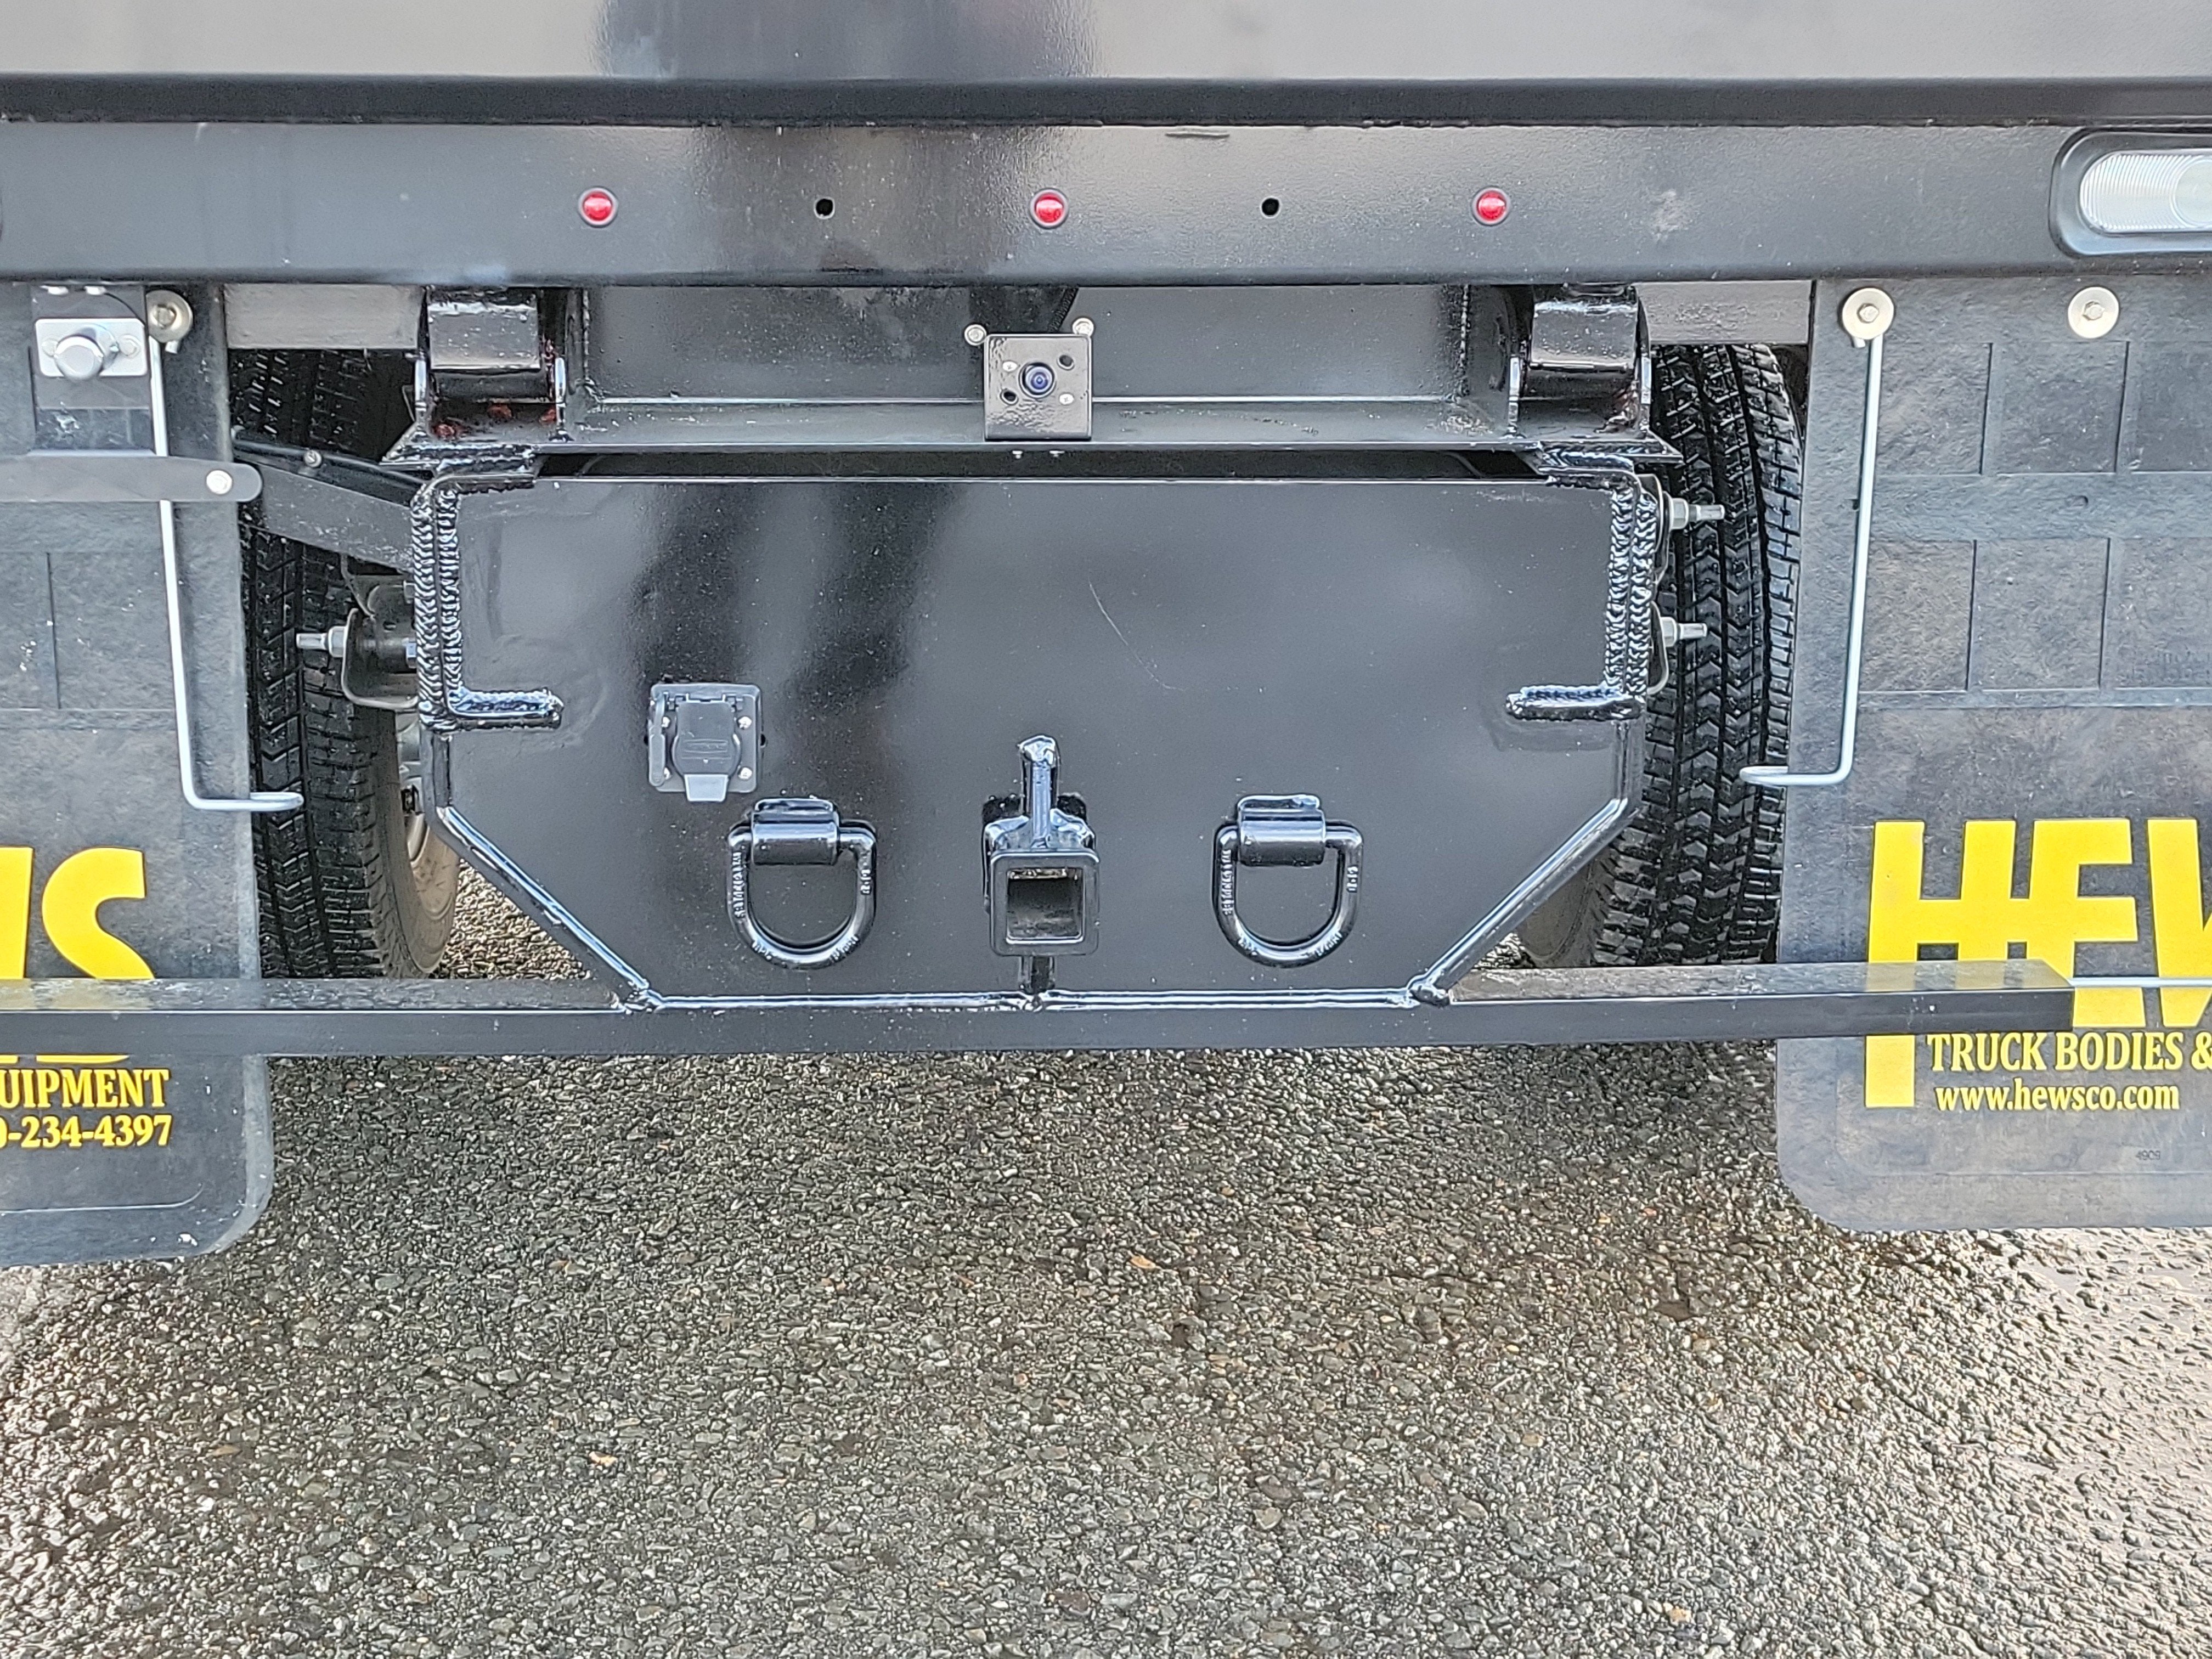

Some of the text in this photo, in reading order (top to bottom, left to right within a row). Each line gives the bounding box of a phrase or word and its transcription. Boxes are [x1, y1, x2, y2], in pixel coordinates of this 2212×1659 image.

[1927, 1031, 2047, 1071] TRUCK
[2055, 1031, 2184, 1071] BODIES
[1936, 1077, 2180, 1111] www.hewsco.com
